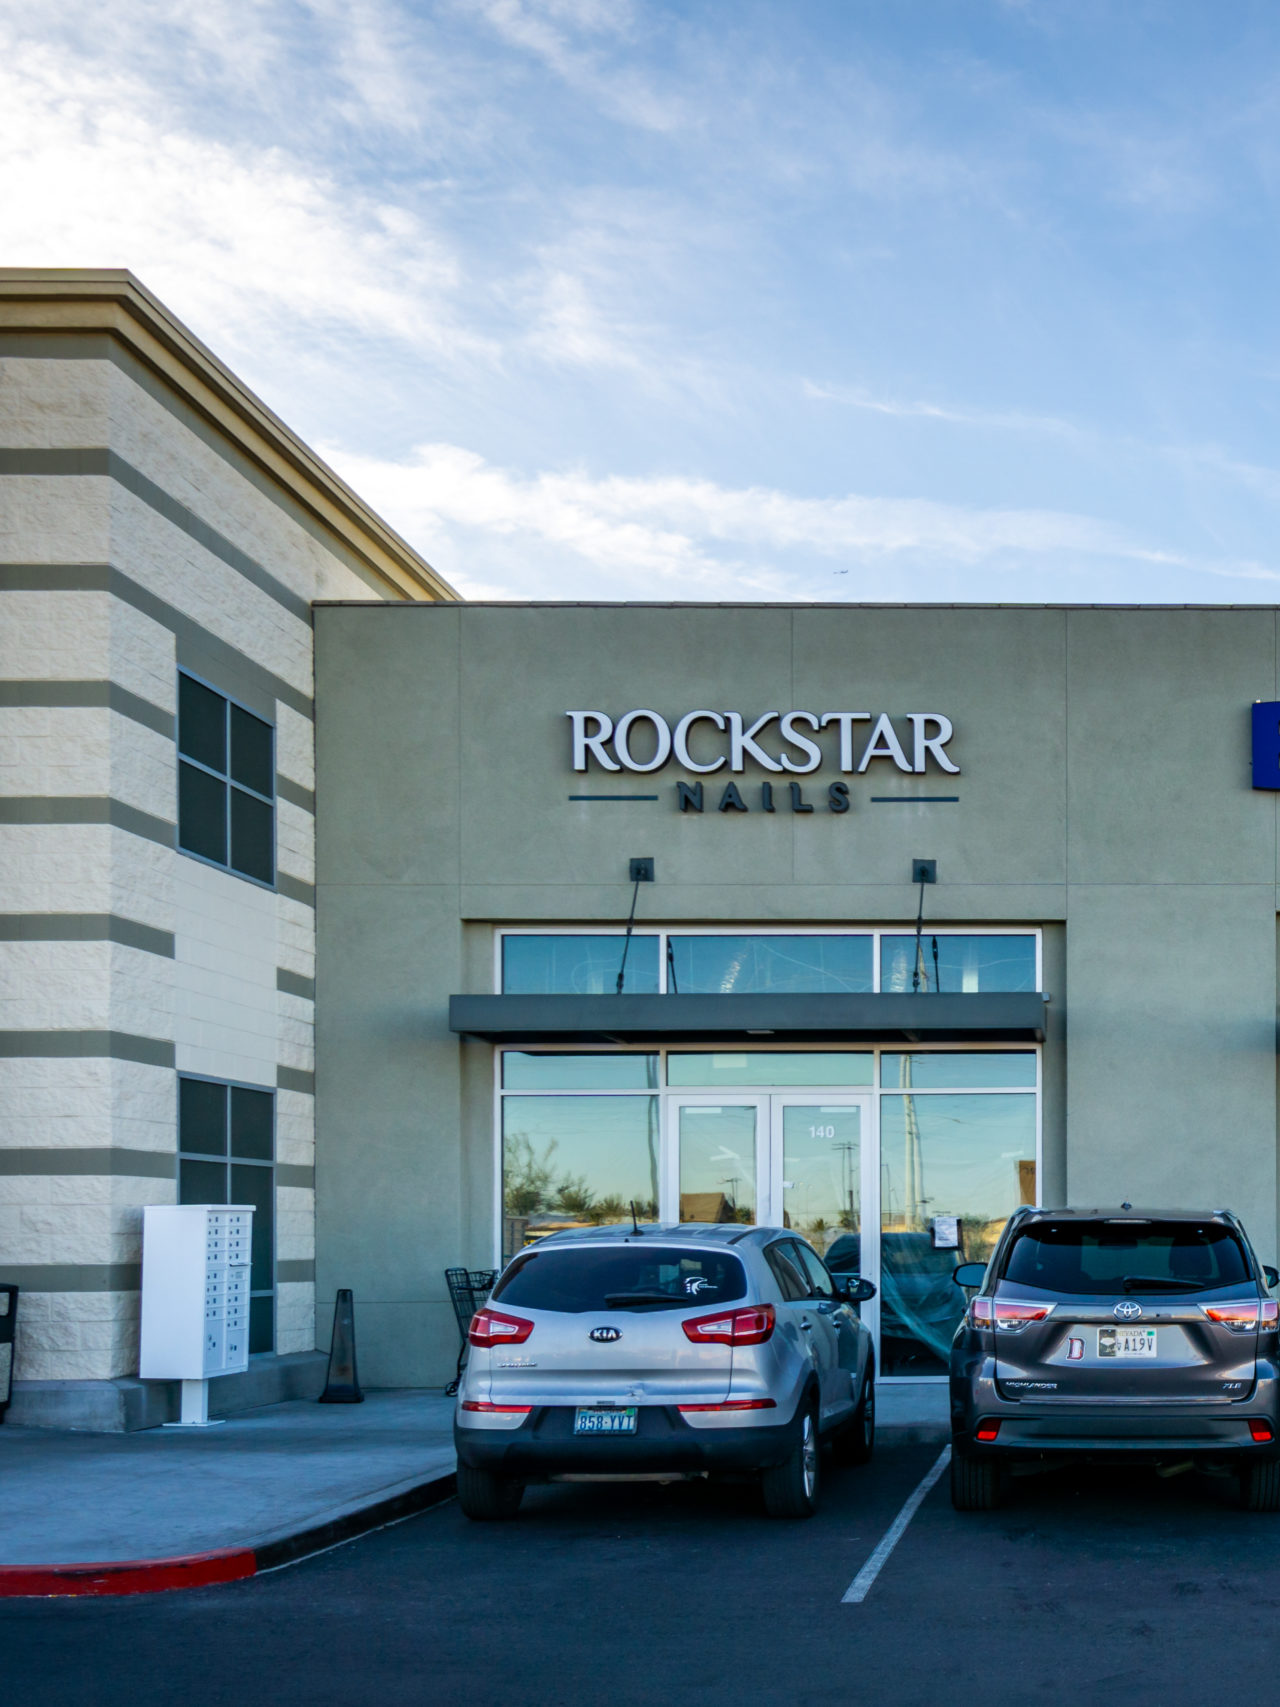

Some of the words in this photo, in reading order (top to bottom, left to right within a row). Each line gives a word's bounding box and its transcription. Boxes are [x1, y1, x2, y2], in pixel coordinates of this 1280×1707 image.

[565, 709, 960, 774] ROCKSTAR
[676, 781, 851, 813] NAILS
[809, 1125, 835, 1139] 140
[593, 1328, 618, 1340] KIA
